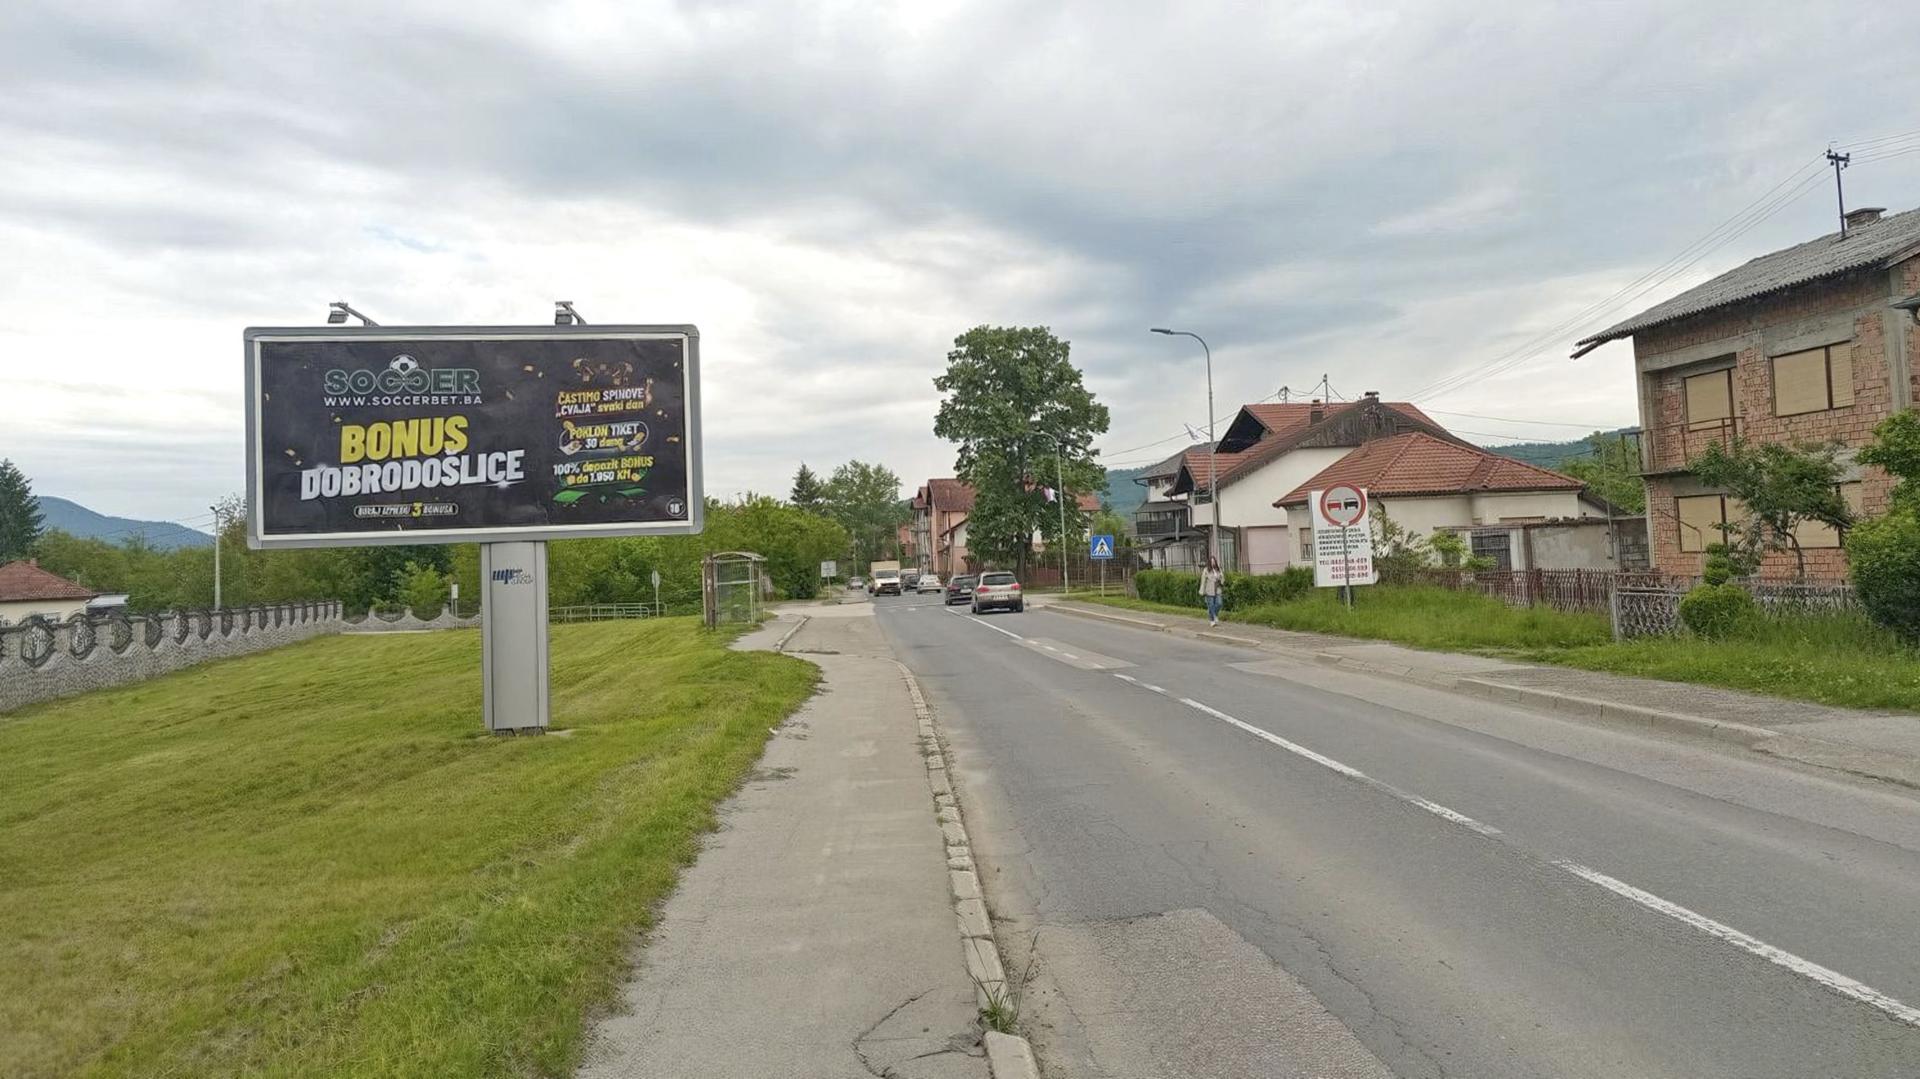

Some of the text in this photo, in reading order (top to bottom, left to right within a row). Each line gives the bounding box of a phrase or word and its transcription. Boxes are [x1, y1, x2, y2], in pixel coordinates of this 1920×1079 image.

[324, 368, 481, 395] SOCCER
[324, 396, 482, 406] WWW.SOCCERBET.BA
[558, 388, 644, 404] ČASTIMO SPINOVE
[598, 400, 624, 412] svaki
[626, 400, 644, 409] dan
[611, 424, 639, 435] TIKET
[340, 415, 469, 463] BONUS
[585, 438, 597, 448] 30
[553, 463, 580, 475] 100%
[621, 456, 654, 466] BONUS
[301, 449, 525, 500] DOBRODOŠLICE
[412, 502, 423, 517] 3
